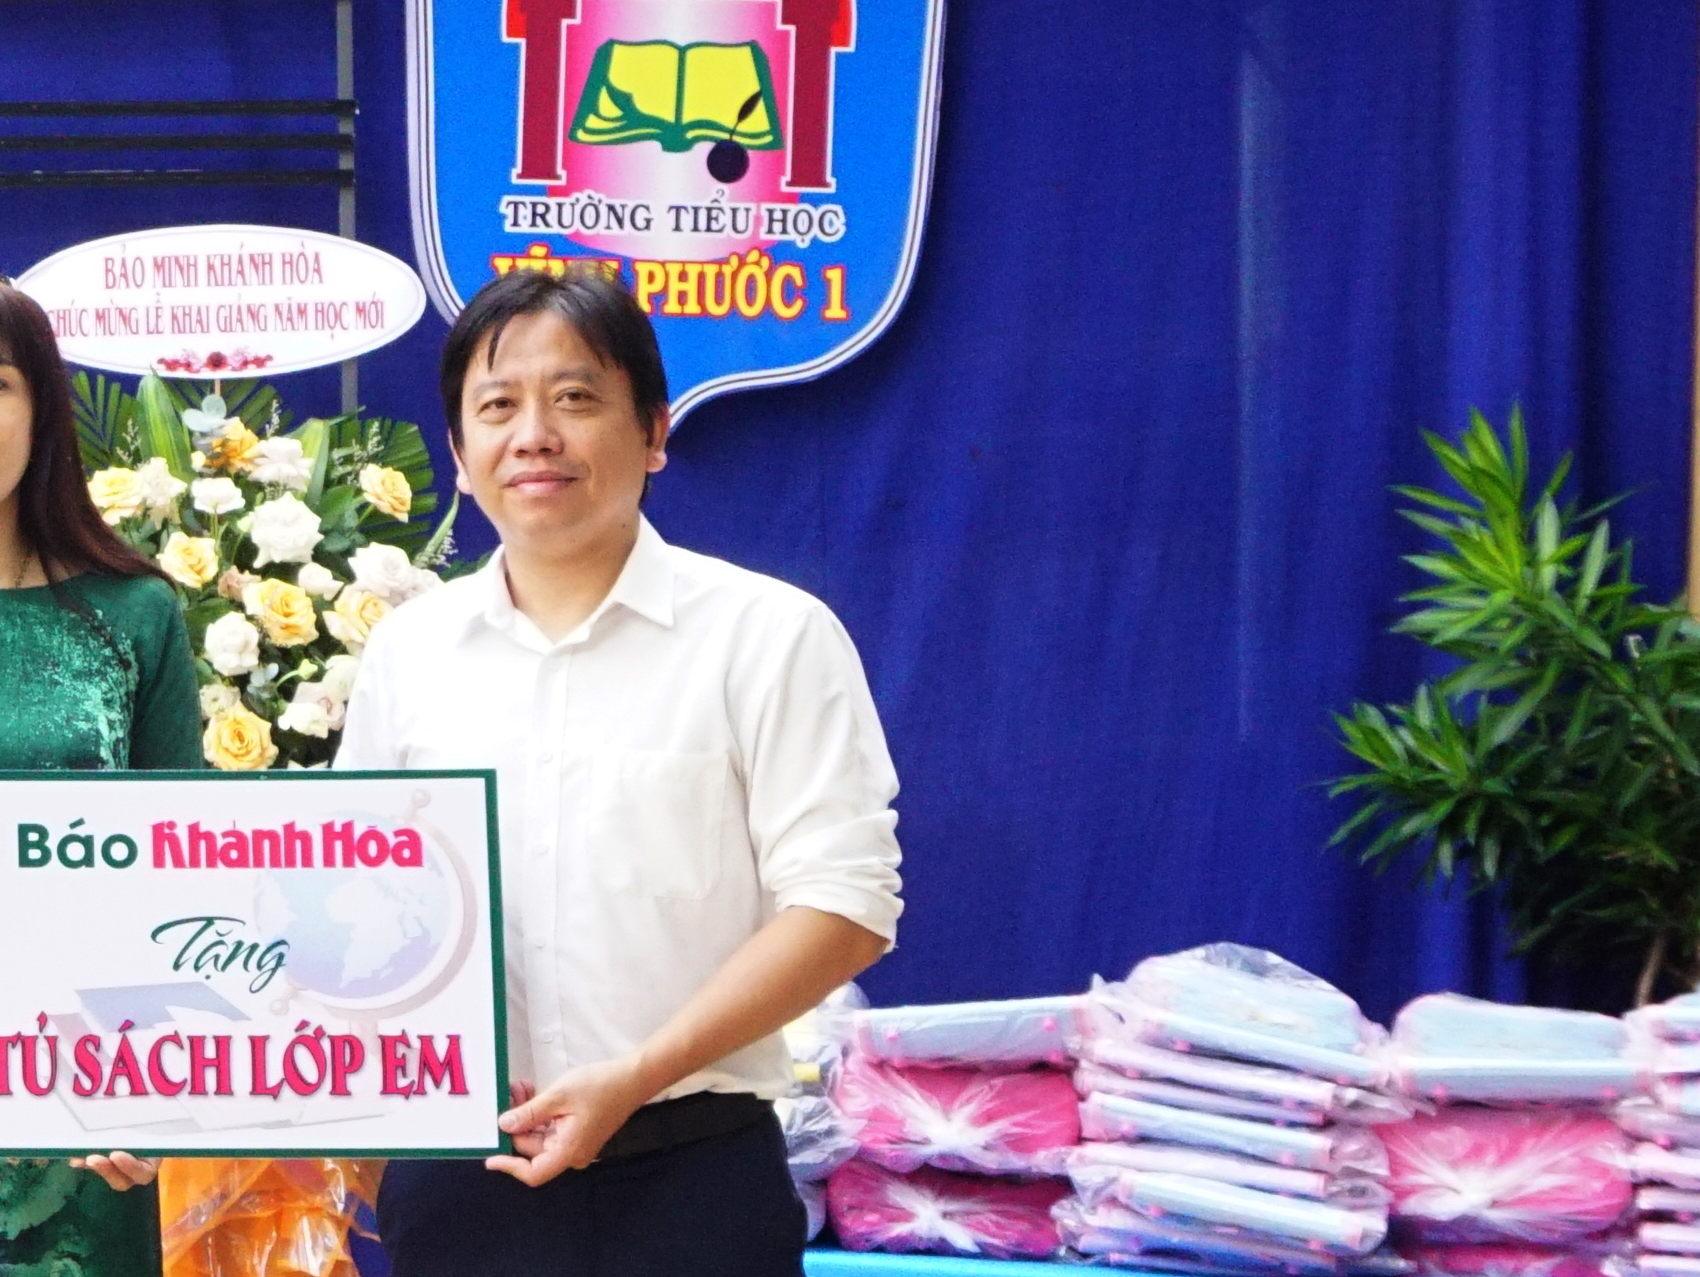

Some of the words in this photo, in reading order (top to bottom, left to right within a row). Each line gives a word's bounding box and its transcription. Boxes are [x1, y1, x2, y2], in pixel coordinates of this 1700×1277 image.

[504, 193, 652, 235] TRƯỜNG
[669, 189, 751, 235] TIỂU
[766, 205, 844, 245] HỌC
[104, 244, 145, 290] BẢO
[152, 254, 197, 288] MINH
[206, 241, 273, 287] KHÁNH
[282, 241, 323, 284] HÒA
[635, 248, 803, 317] PHƯỚC
[824, 268, 846, 319] 1
[95, 301, 139, 336] MỪNG
[146, 291, 164, 335] LỄ
[171, 303, 209, 334] KHAI
[216, 294, 267, 333] GIẢNG
[274, 297, 309, 331] NĂM
[314, 302, 348, 340] HỌC
[354, 294, 384, 330] MỚI
[18, 818, 137, 869] Báo
[151, 916, 290, 993] Tặng
[73, 1019, 238, 1098] SÁCH
[248, 1020, 365, 1100] LỚP
[379, 1029, 468, 1099] EM
